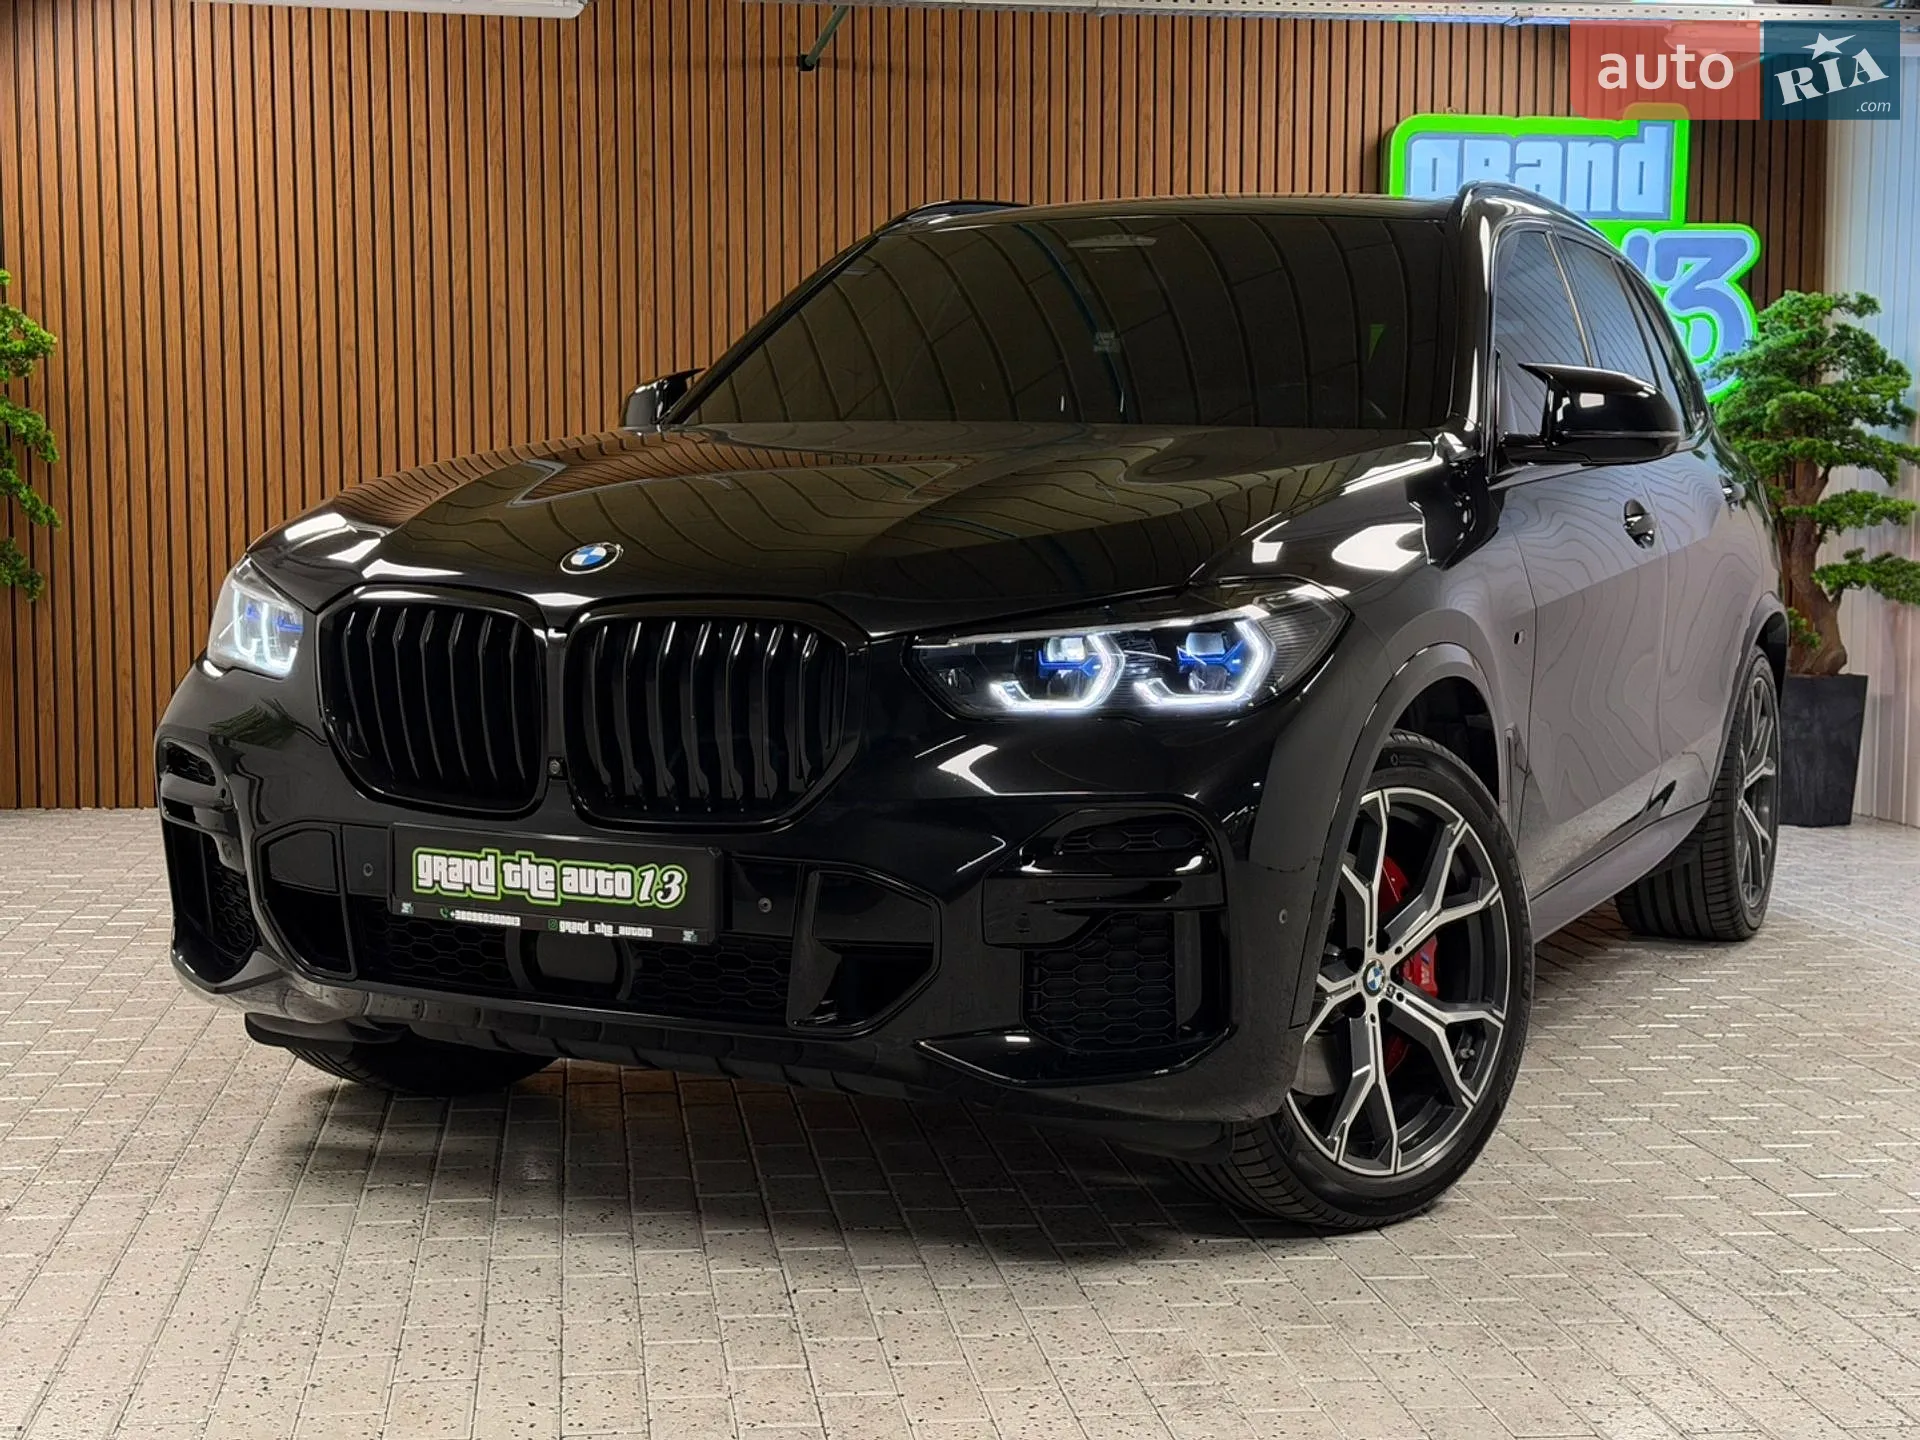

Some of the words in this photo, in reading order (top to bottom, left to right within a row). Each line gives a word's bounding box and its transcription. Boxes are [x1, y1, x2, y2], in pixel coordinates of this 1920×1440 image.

[417, 853, 496, 895] grand
[502, 857, 556, 899] the
[561, 865, 632, 898] auto
[637, 867, 685, 903] 13
